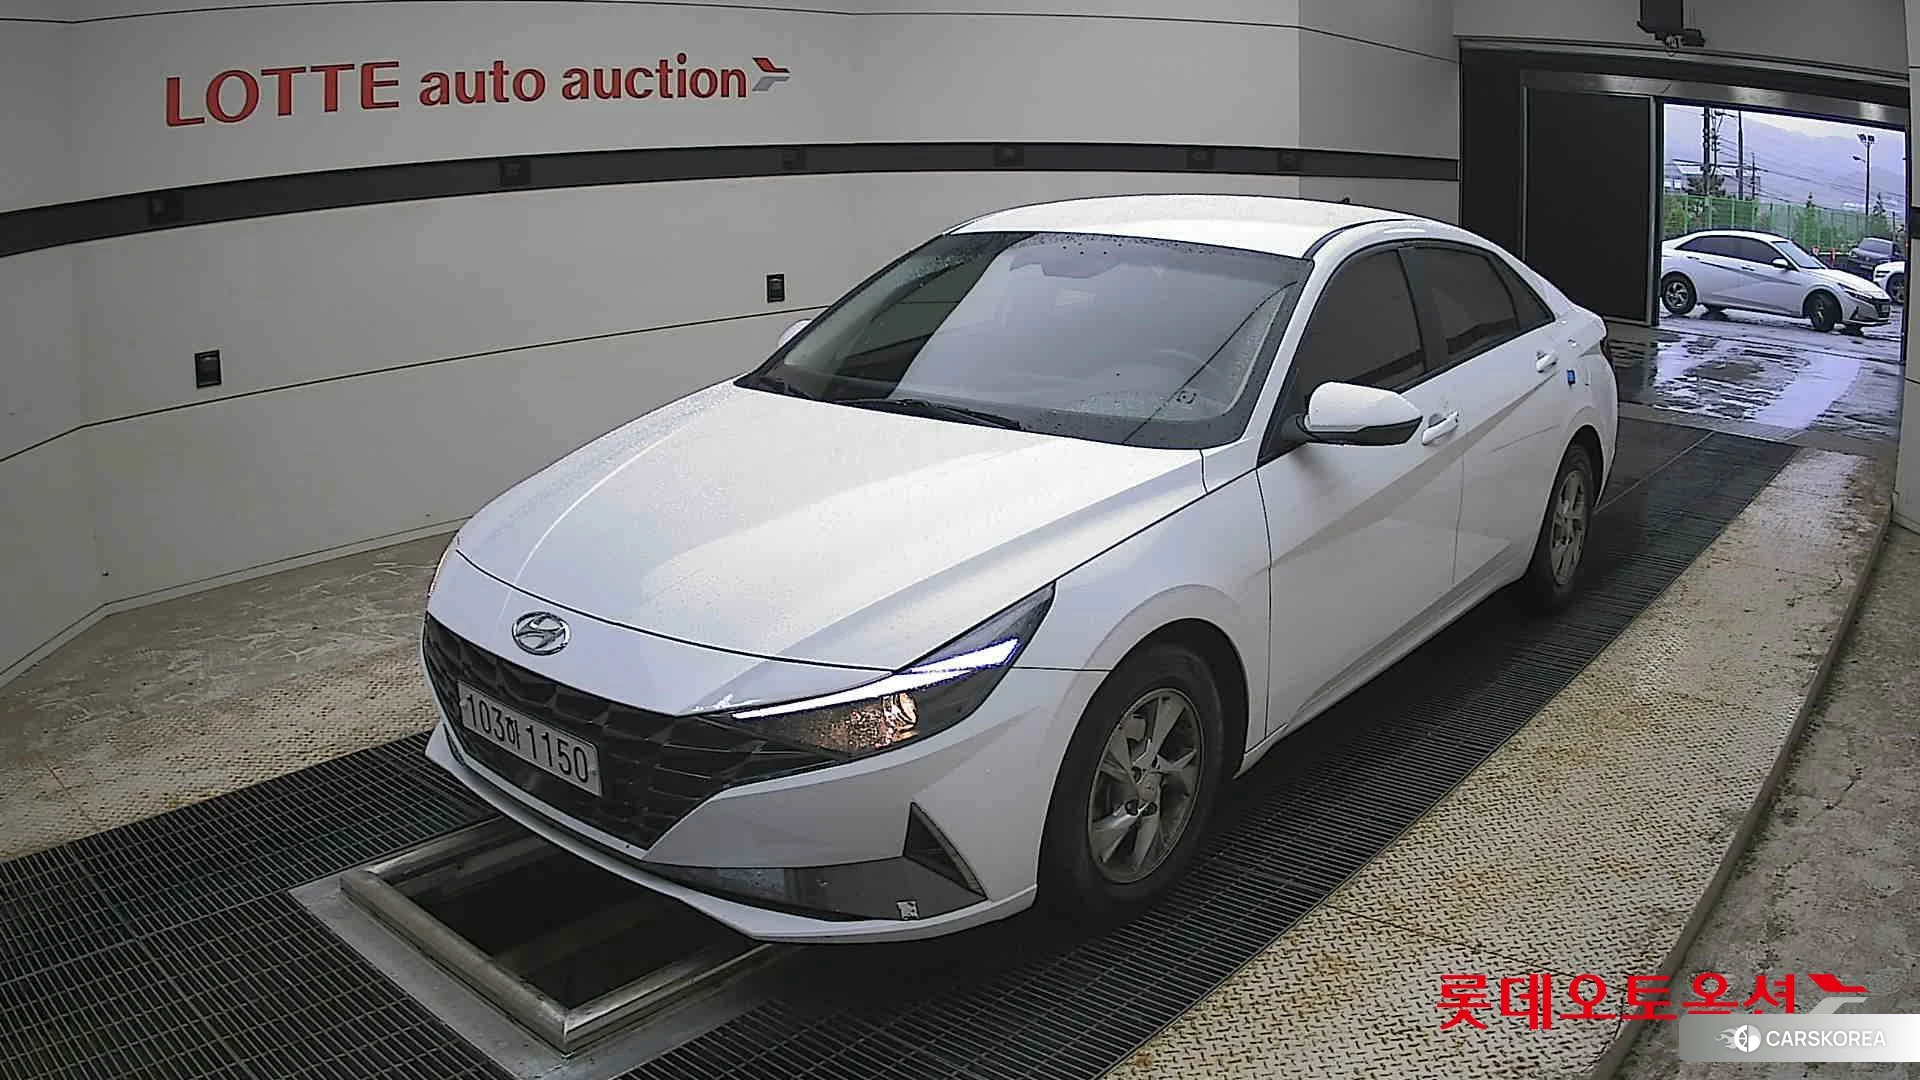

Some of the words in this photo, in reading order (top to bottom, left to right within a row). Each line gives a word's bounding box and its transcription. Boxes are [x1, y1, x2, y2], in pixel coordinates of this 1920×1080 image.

[165, 60, 400, 127] LOTTE
[420, 60, 546, 106] auto
[562, 52, 748, 99] auction
[526, 725, 588, 783] 1150
